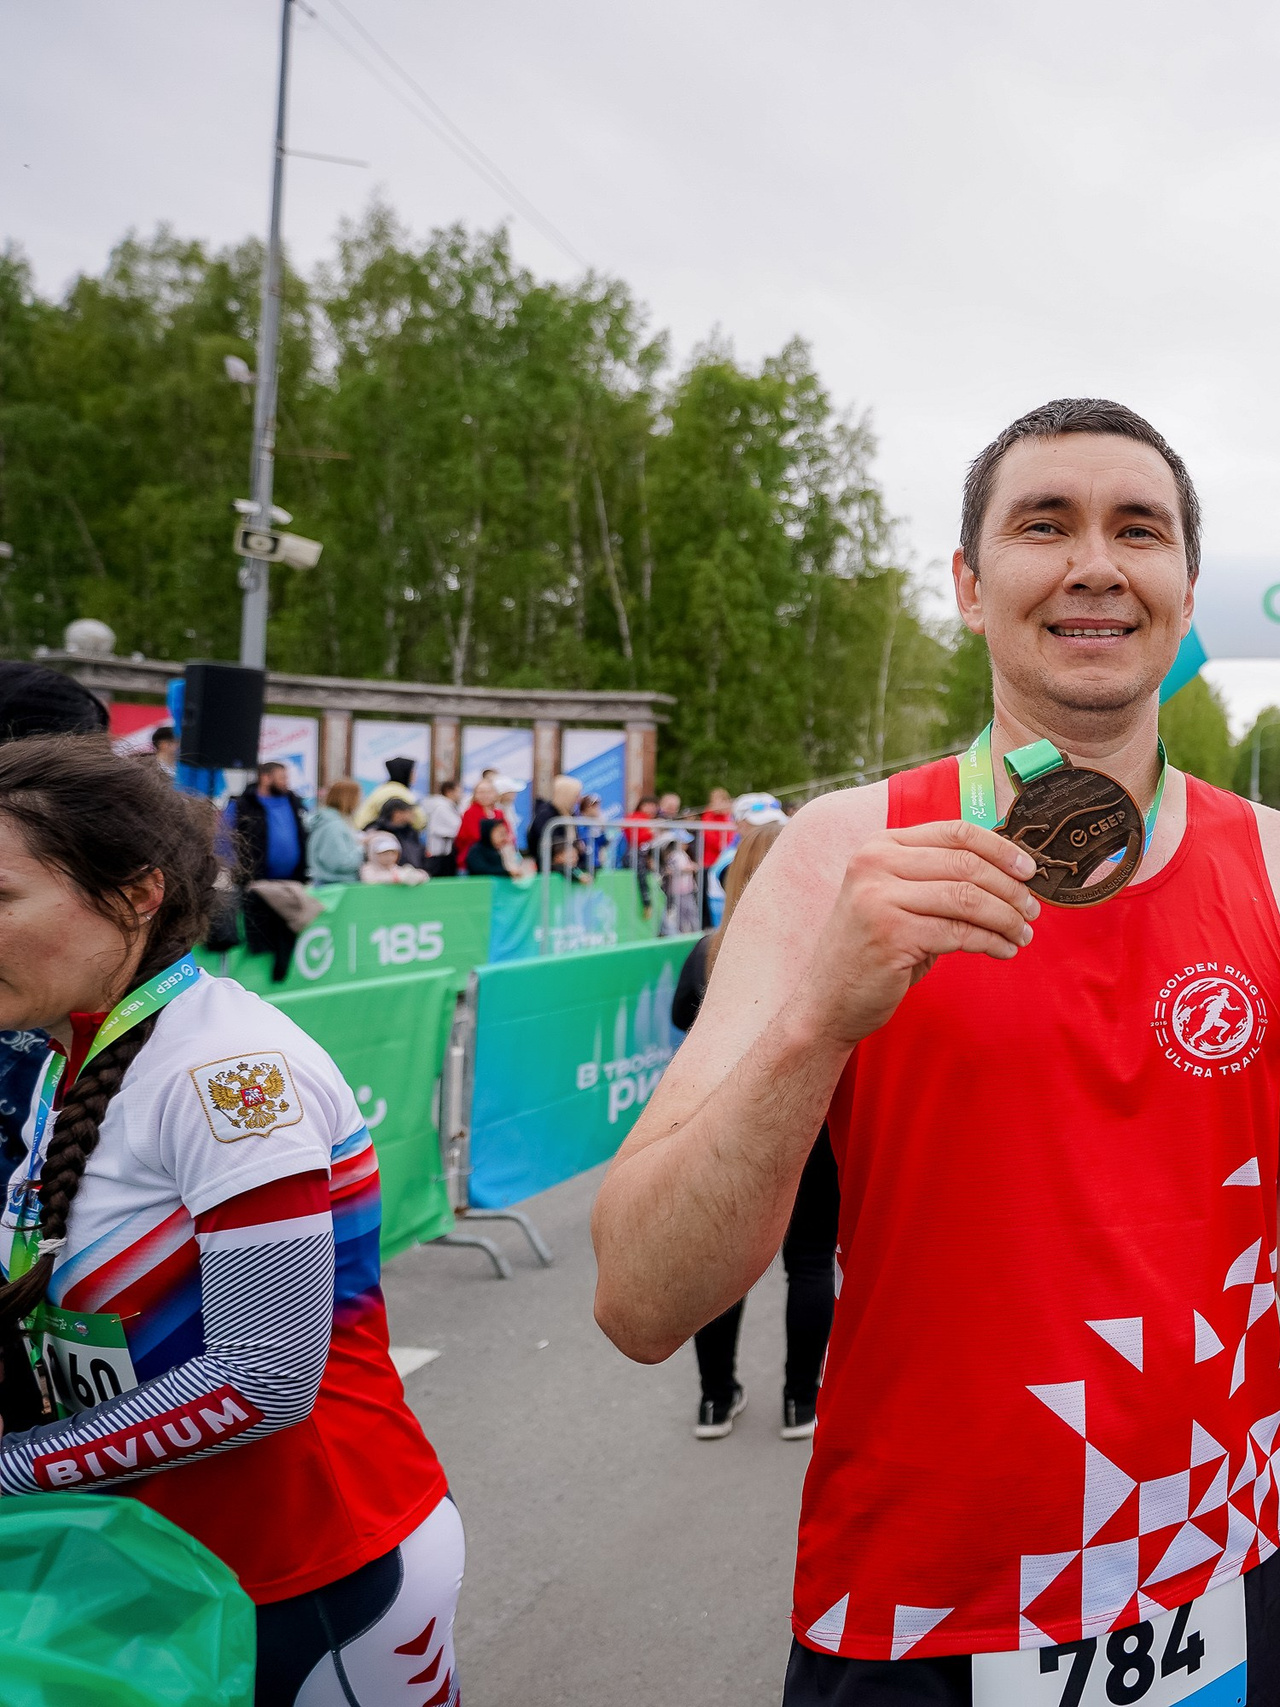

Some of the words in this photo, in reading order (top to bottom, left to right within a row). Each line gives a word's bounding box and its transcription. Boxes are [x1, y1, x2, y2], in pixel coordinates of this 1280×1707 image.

[1089, 811, 1126, 836] СБЕР
[370, 920, 444, 965] 185
[156, 972, 184, 994] СБЕР
[1159, 962, 1218, 998] GOLDEN
[1224, 965, 1259, 996] RING
[120, 999, 145, 1018] 185
[1165, 1047, 1213, 1078] ULTRA
[1219, 1046, 1261, 1076] TRAIL
[45, 1396, 250, 1487] BIVIUM
[1039, 1600, 1206, 1707] 784
